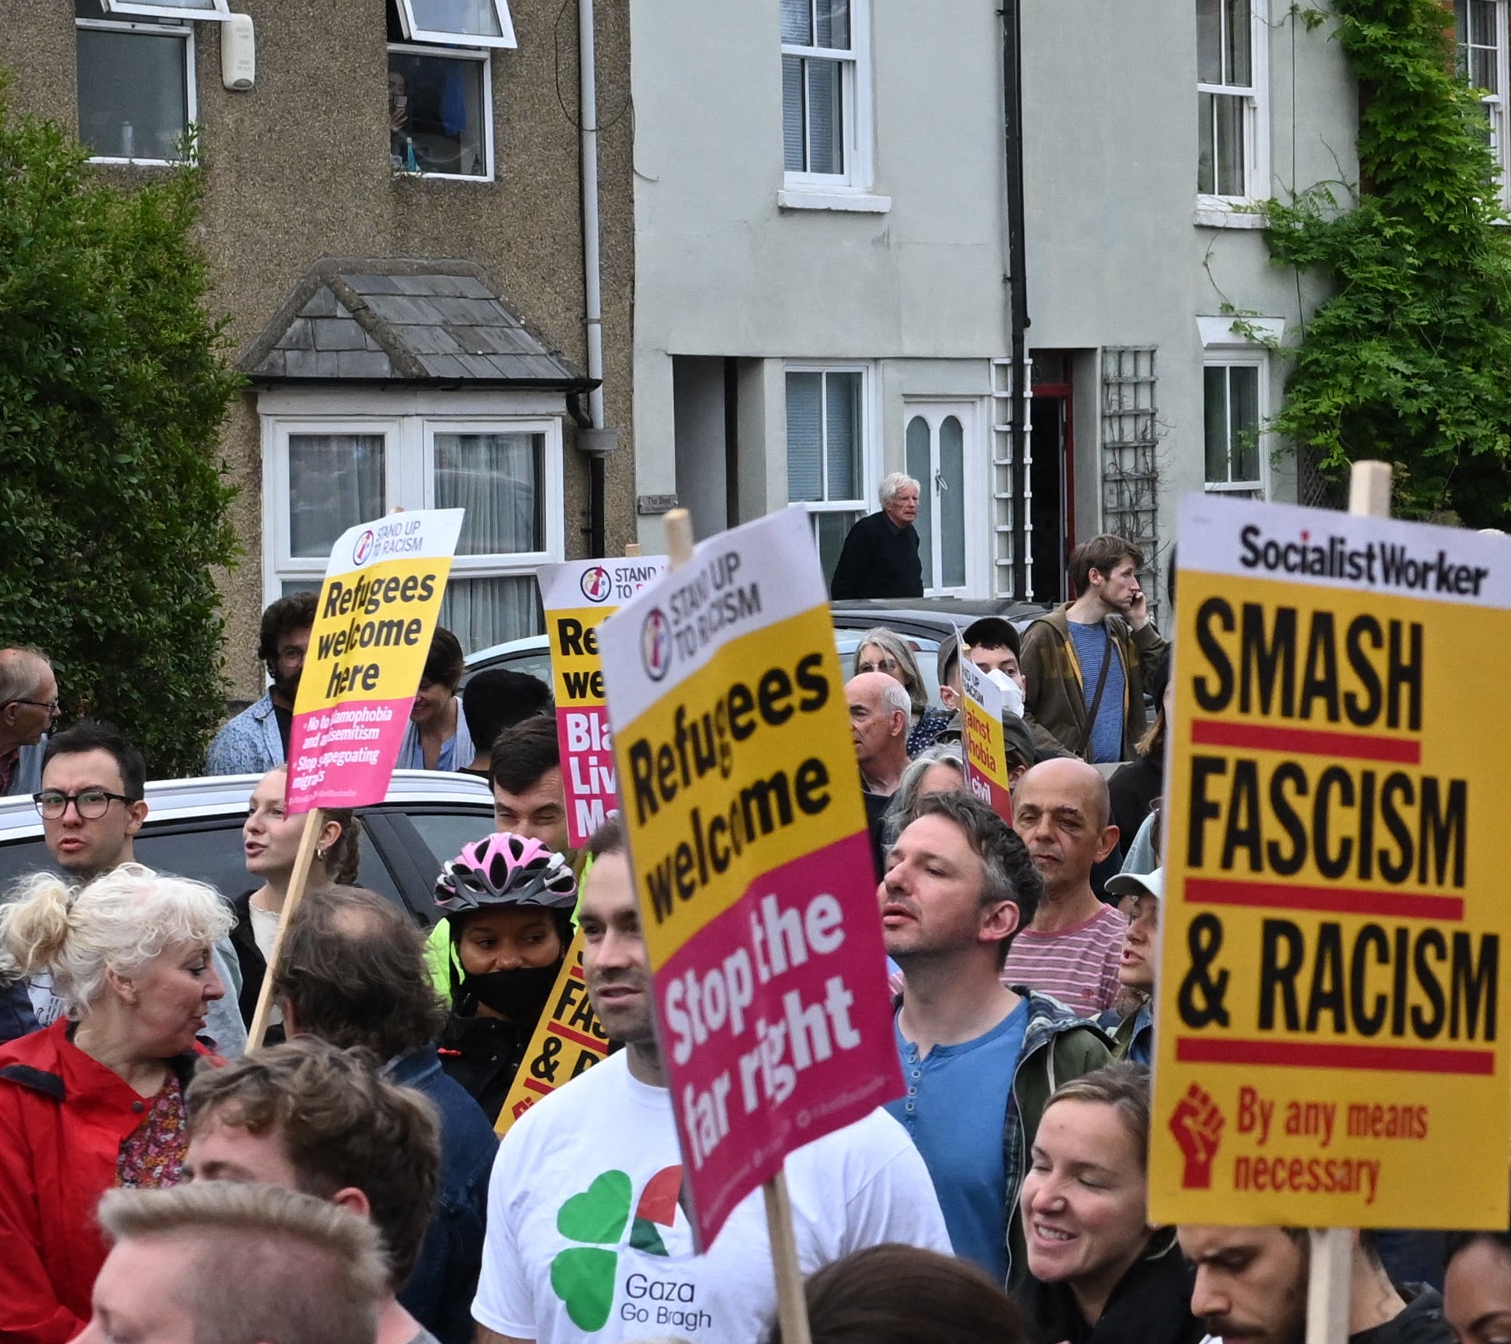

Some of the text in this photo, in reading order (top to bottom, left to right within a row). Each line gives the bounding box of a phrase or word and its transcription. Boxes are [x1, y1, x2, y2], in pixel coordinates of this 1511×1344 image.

[383, 537, 423, 554] RACISM
[404, 521, 421, 535] UP
[710, 551, 741, 591] UP
[1239, 524, 1488, 598] Socialist Worker
[323, 574, 436, 619] Refugees
[615, 585, 633, 599] TO
[317, 617, 422, 661] welcome
[325, 662, 380, 699] here
[1192, 596, 1424, 731] SMASH
[566, 714, 612, 752] Bla
[628, 652, 829, 828] Refugees
[966, 710, 991, 744] ainst
[570, 757, 615, 795] Liv
[646, 756, 831, 925] welcome
[1186, 754, 1468, 889] FASCISM
[665, 947, 754, 1065] Stop
[750, 893, 846, 985] the
[1176, 913, 1499, 1041] & RACISM
[530, 1036, 562, 1083] &
[683, 1069, 731, 1170] far
[739, 975, 862, 1115] right
[1237, 1085, 1429, 1148] By any means
[1234, 1155, 1381, 1206] necessary
[625, 1273, 695, 1303] Gaza
[620, 1302, 712, 1331] Go Bragh
